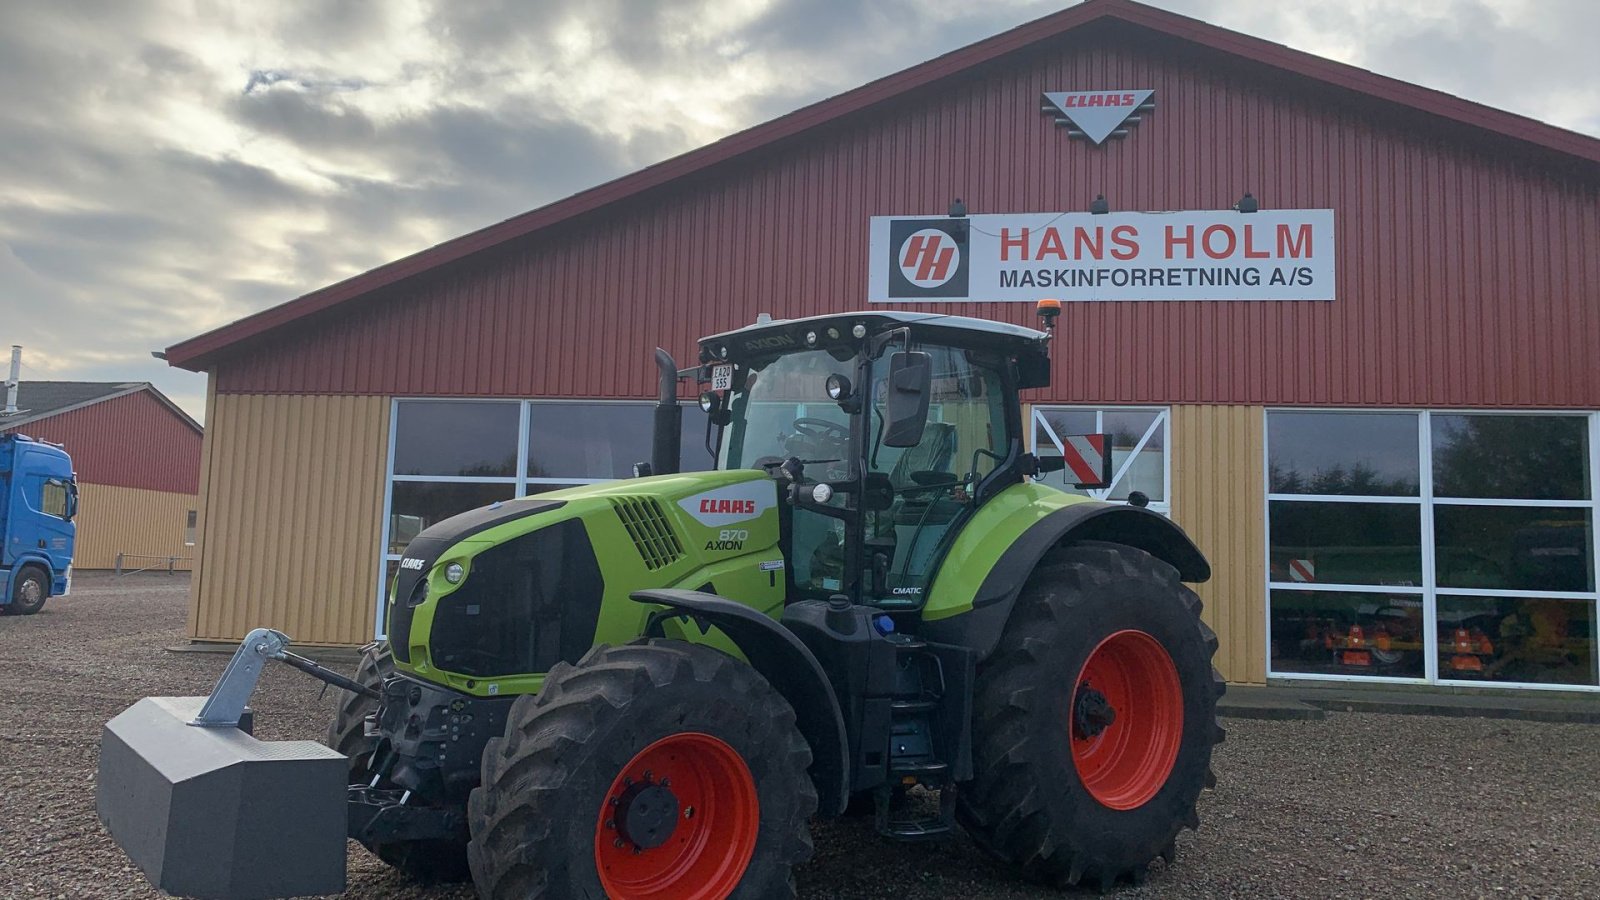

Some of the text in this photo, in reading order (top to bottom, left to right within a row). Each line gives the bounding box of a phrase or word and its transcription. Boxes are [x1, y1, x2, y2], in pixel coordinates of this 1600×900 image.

[1065, 94, 1135, 108] CLAAS
[1000, 223, 1313, 261] HANS HOLM
[902, 235, 955, 281] HH
[1000, 266, 1314, 288] MASKINFORRETNING A/S
[745, 334, 795, 350] AXION
[699, 499, 755, 514] CLAAS
[719, 529, 749, 541] 870
[704, 540, 743, 551] AXION
[401, 558, 425, 570] CLAAS
[892, 587, 922, 595] CMATIC
